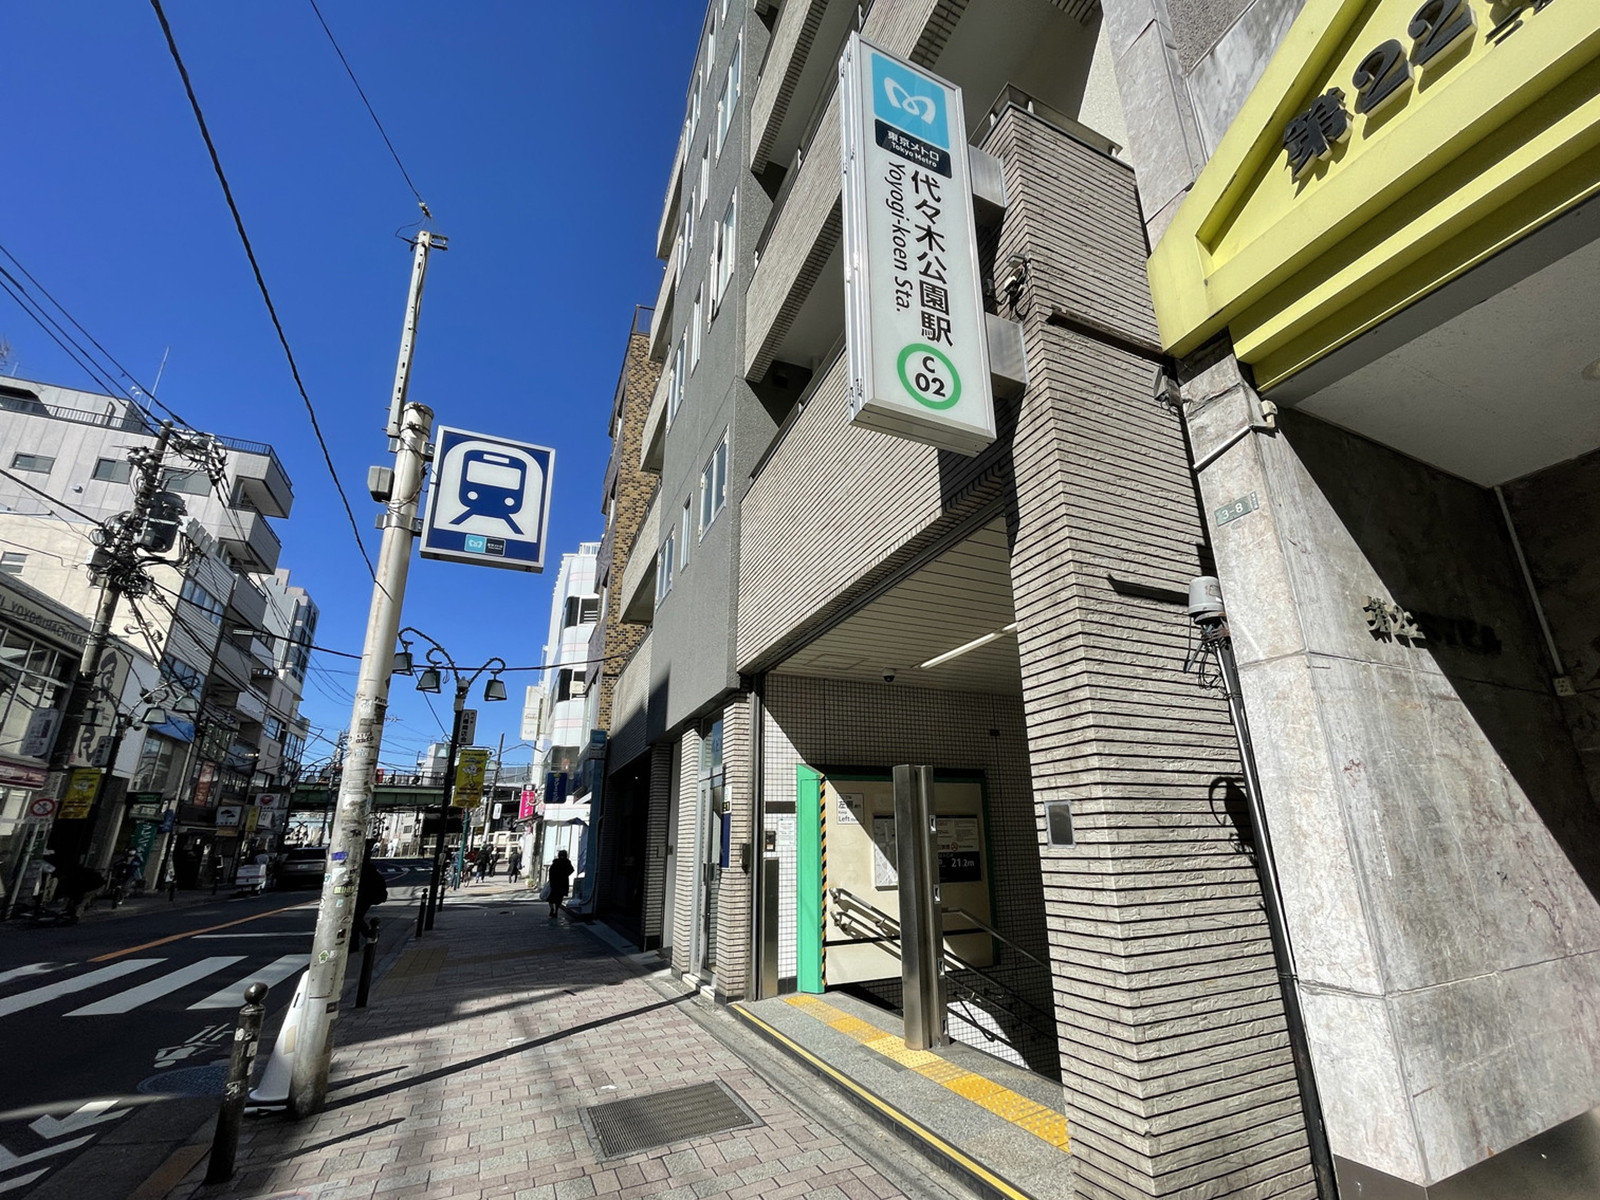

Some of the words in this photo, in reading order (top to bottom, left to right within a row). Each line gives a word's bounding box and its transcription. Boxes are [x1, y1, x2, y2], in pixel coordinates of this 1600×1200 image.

[887, 130, 940, 162] 東京メトロ
[891, 141, 914, 158] Tokyo
[914, 152, 938, 168] Metro
[884, 161, 911, 272] Yoyogi-koen
[910, 169, 954, 347] 代々木公園駅
[894, 276, 914, 313] Sta.
[922, 355, 936, 374] C
[914, 373, 946, 398] 02
[1221, 502, 1244, 520] 3-8
[951, 857, 975, 869] 21.2m
